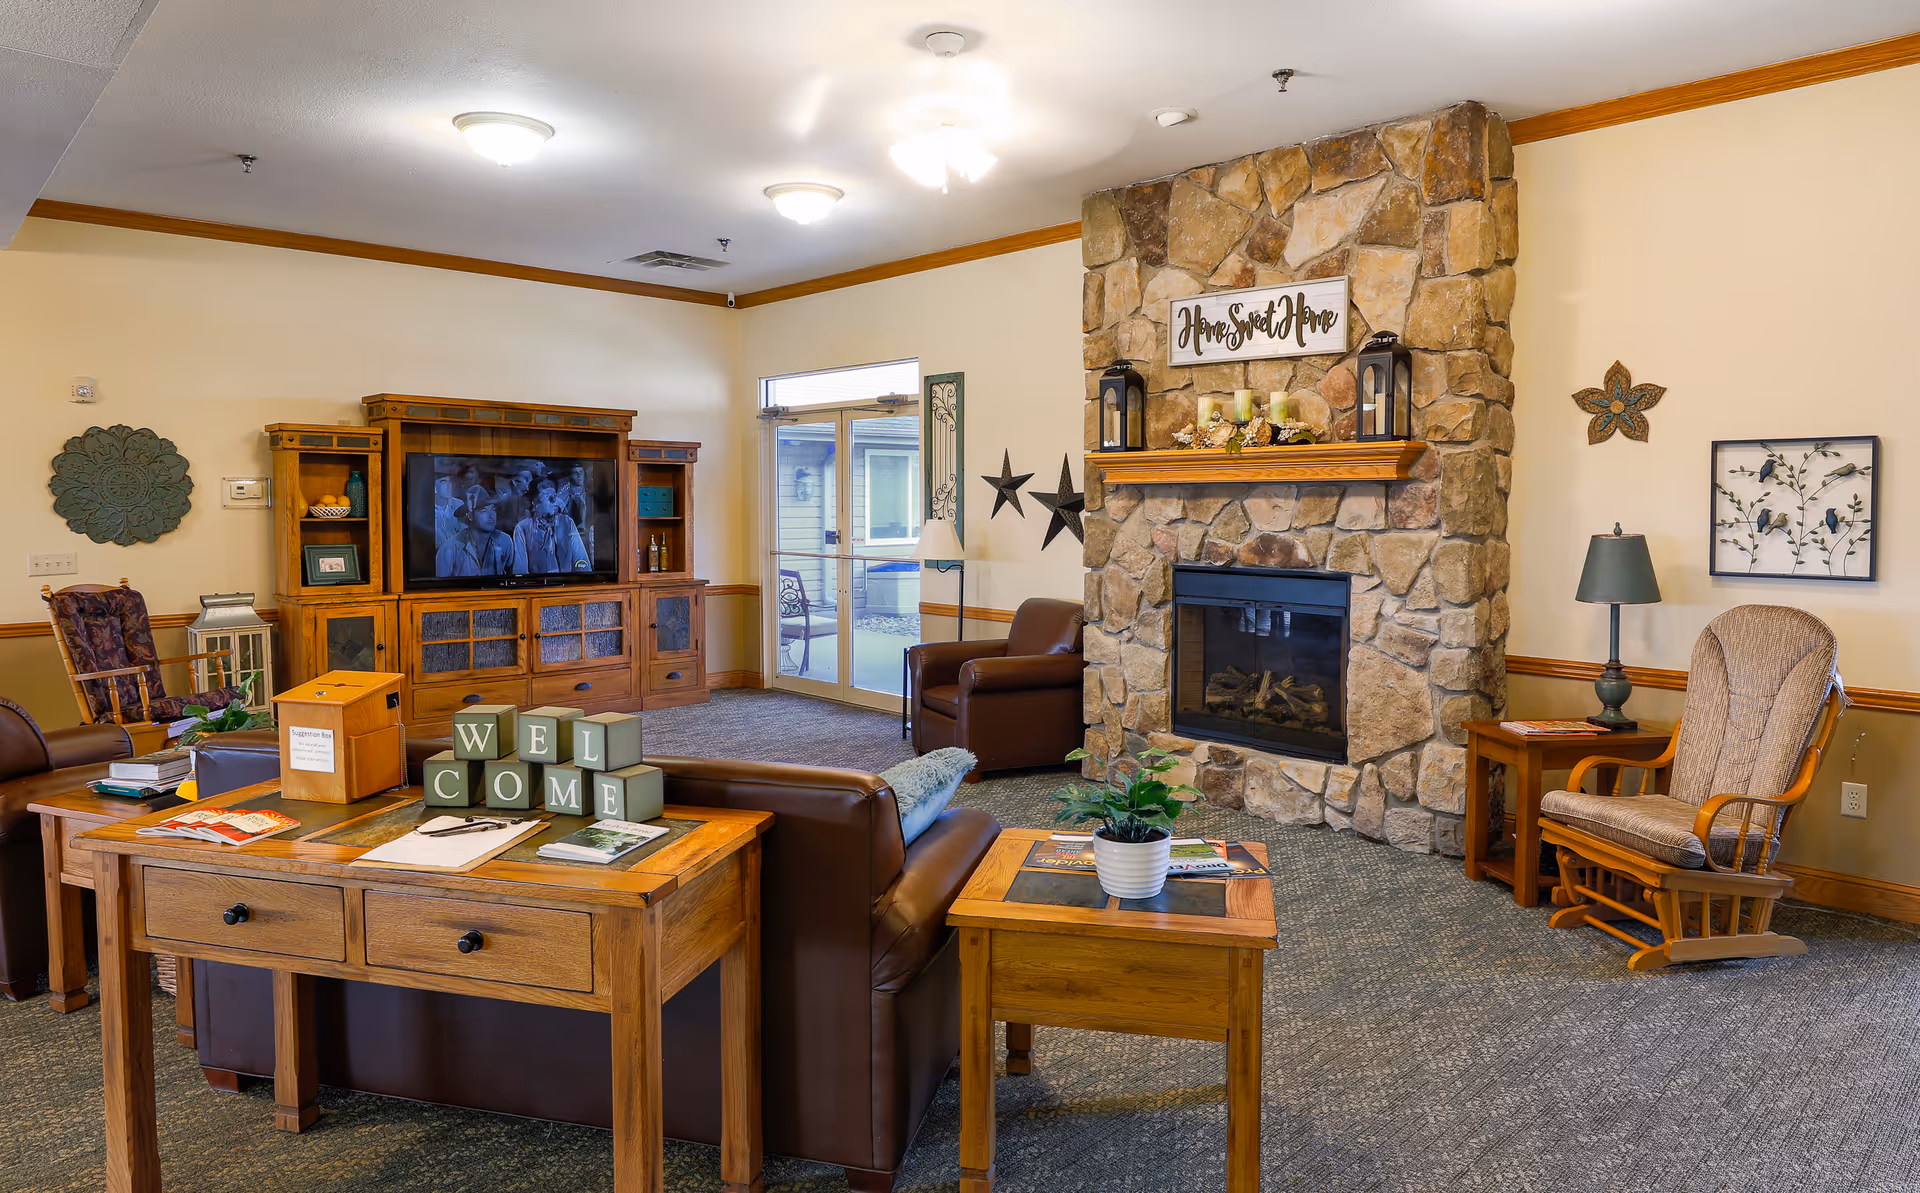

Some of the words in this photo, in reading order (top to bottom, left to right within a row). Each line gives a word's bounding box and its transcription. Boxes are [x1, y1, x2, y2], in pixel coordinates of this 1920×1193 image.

[1178, 304, 1230, 356] Home
[1226, 300, 1279, 351] Sweet
[1277, 292, 1339, 348] Home
[291, 729, 321, 738] Suggestion
[321, 731, 333, 739] Box
[1036, 858, 1097, 866] ovider
